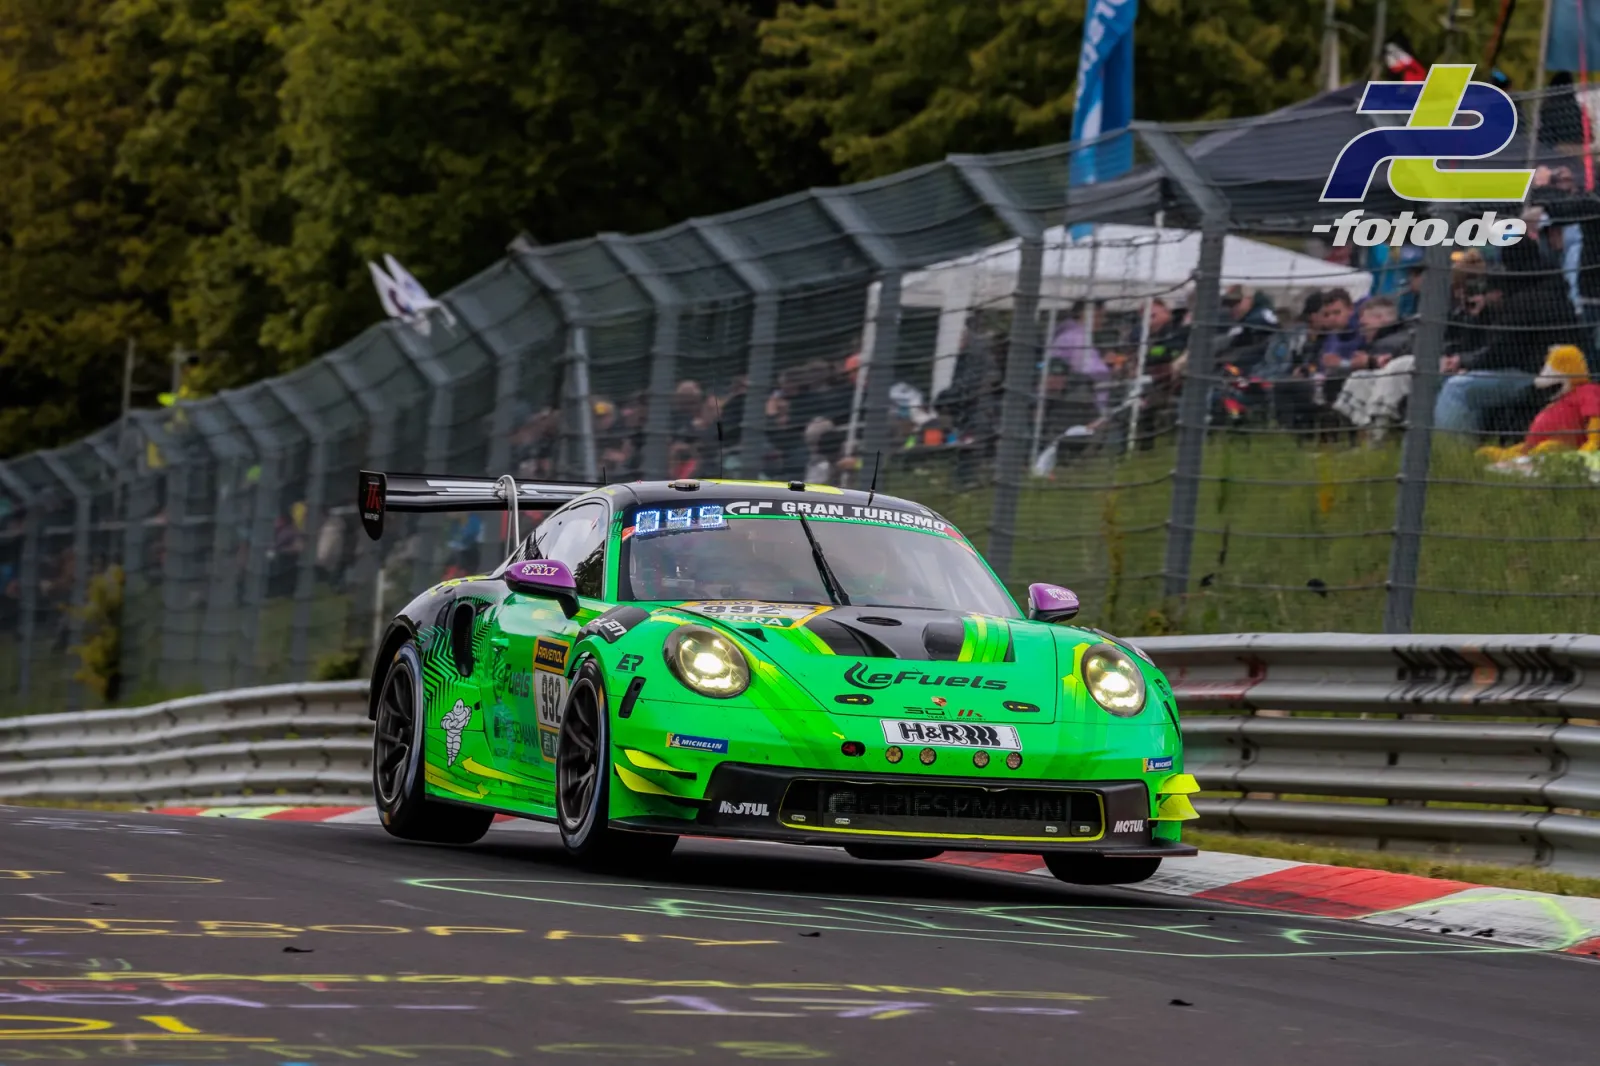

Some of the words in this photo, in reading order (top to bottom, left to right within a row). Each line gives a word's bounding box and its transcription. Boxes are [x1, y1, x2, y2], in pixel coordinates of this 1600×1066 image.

[635, 505, 723, 534] 045
[781, 501, 843, 515] GRAN
[852, 506, 946, 531] TURISMO
[842, 516, 888, 525] DRIVING
[889, 521, 949, 537] SIMULATOR
[525, 565, 559, 576] KW
[702, 605, 782, 615] 992
[537, 646, 564, 664] RAVENOL
[867, 671, 1008, 691] eFuels
[541, 674, 562, 724] 992
[898, 721, 960, 746] H&R
[681, 738, 723, 750] MICHELIN
[718, 800, 771, 817] MOTUL
[1113, 819, 1145, 833] MOTUL
